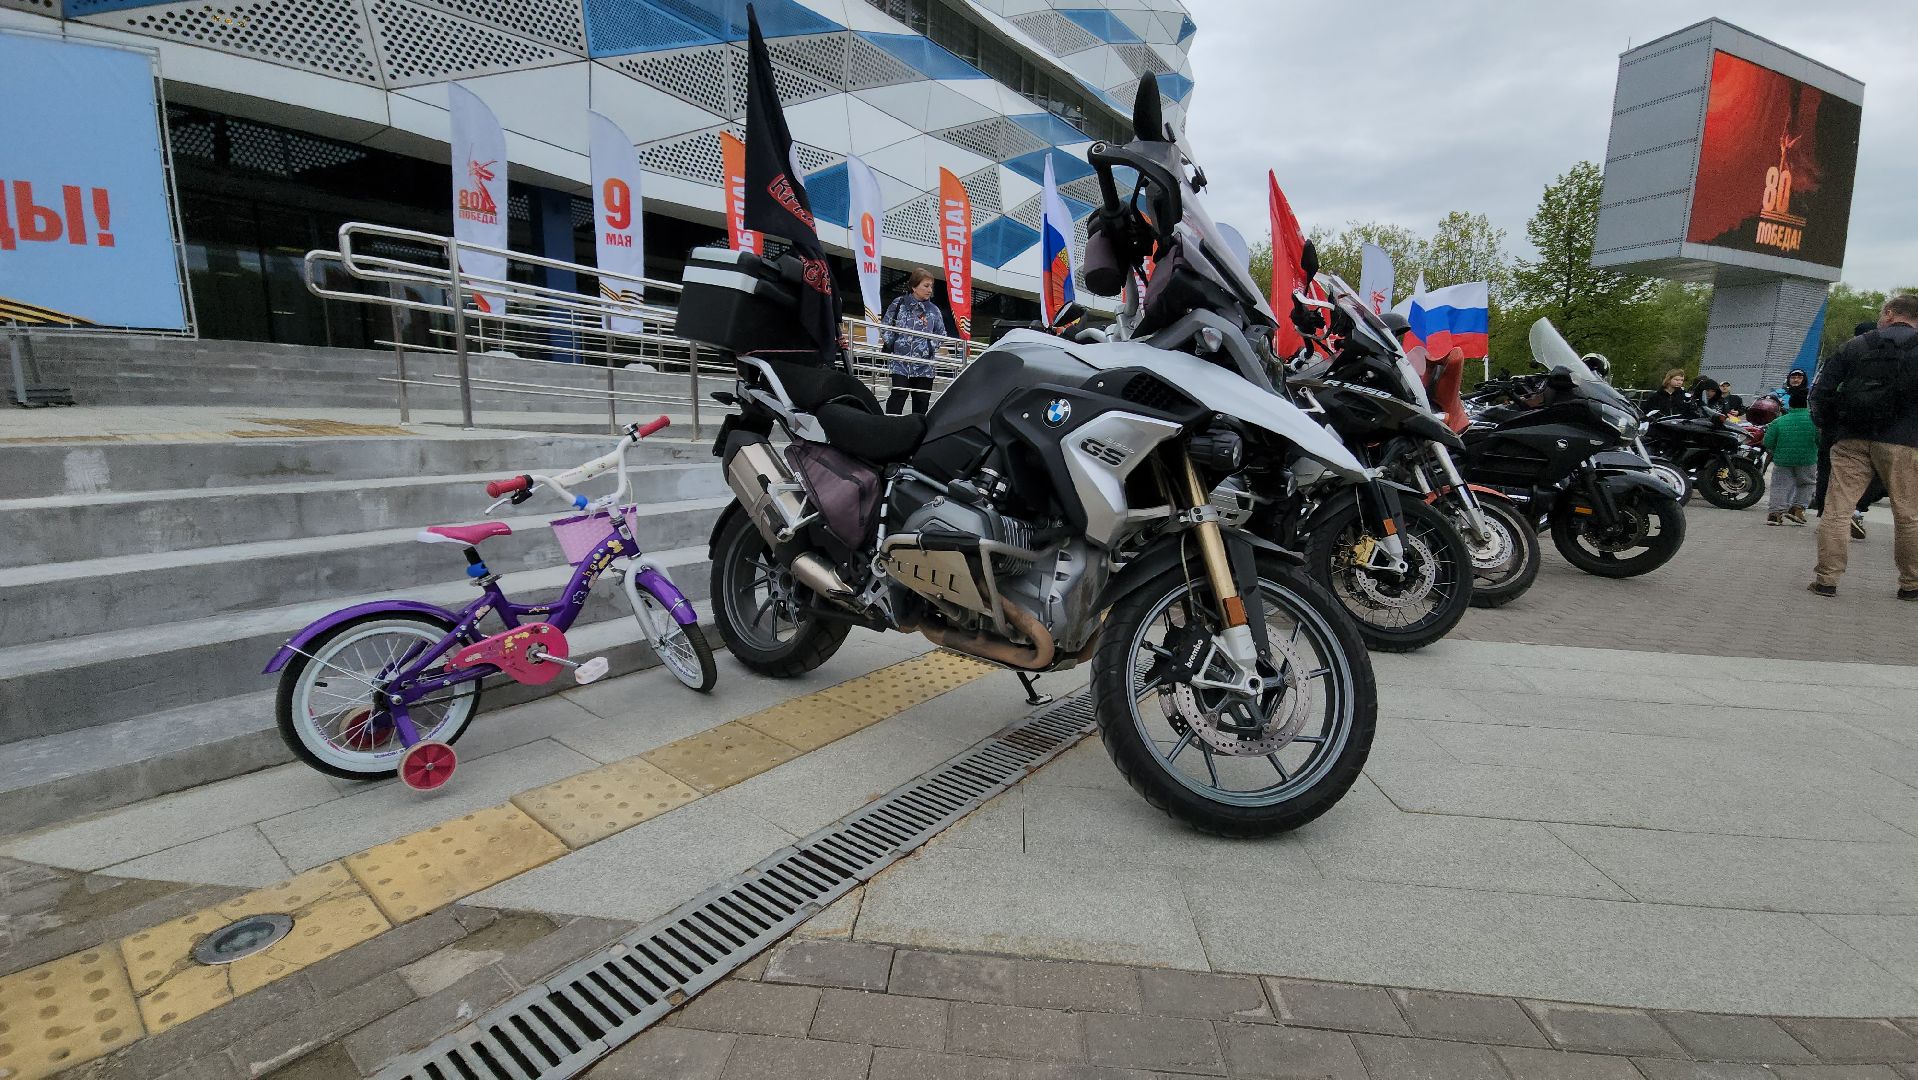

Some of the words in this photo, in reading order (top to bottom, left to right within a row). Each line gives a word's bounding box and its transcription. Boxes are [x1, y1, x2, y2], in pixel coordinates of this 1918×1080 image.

[458, 188, 480, 209] 80
[603, 177, 631, 230] 9
[1762, 166, 1792, 213] 80
[0, 179, 116, 251] Ы!
[458, 209, 498, 225] ПОБЕДА!
[605, 232, 633, 249] МАЯ
[861, 212, 875, 259] 9
[1756, 221, 1802, 252] ПОБЕДА!
[944, 199, 967, 304] ПОБЕДА!
[1080, 438, 1126, 467] GS
[1184, 639, 1204, 669] brembo
